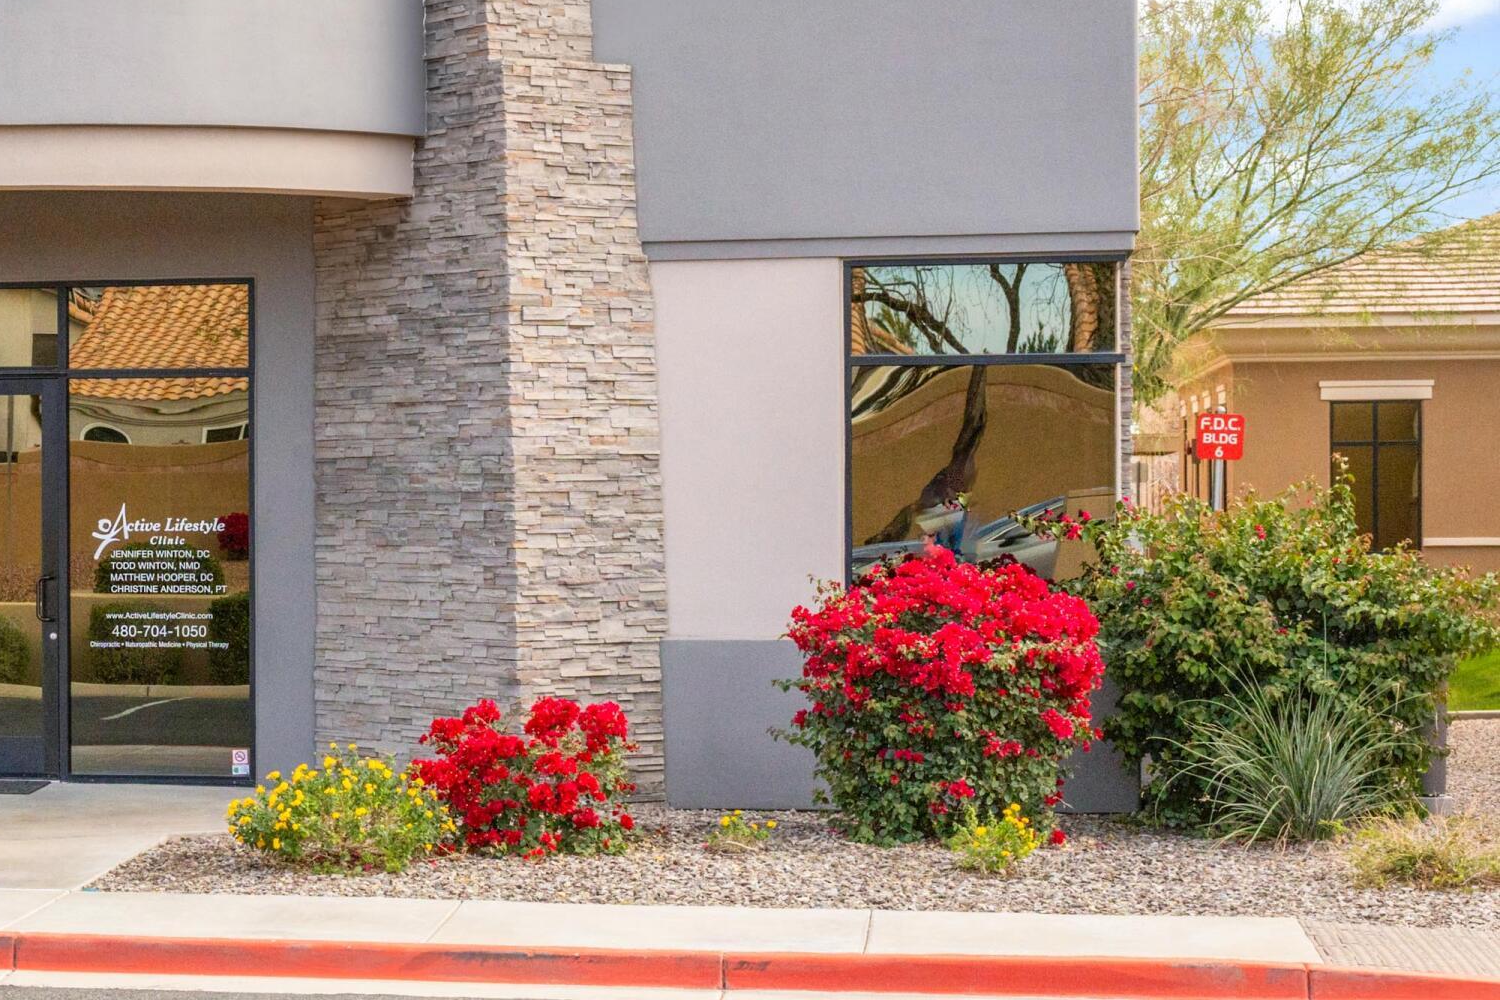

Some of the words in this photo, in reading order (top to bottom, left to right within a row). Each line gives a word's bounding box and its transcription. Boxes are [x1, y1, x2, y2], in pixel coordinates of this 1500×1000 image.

[1200, 417, 1241, 431] F.D.C.
[1202, 433, 1238, 445] BLDG
[1214, 446, 1224, 458] 6
[164, 517, 226, 534] Lifestyle
[150, 535, 185, 545] Clinic
[110, 550, 155, 559] JENNIFER
[156, 550, 195, 560] WINTON,
[197, 550, 210, 559] DC
[110, 562, 136, 570] TODD
[138, 562, 177, 571] WINTON,
[179, 561, 200, 570] NMD
[110, 573, 155, 582] MATTHEW
[157, 573, 198, 583] HOOPER,
[200, 573, 214, 582] DC
[110, 585, 159, 593] CHRISTINE
[160, 585, 213, 594] ANDERSON,
[215, 585, 228, 593] PT
[105, 612, 213, 620] www.ActiveLifestyleClinic.com
[111, 625, 207, 638] 480-704-1050
[90, 641, 121, 649] Chiropractic
[186, 641, 208, 649] Physical
[209, 641, 230, 650] Therapy
